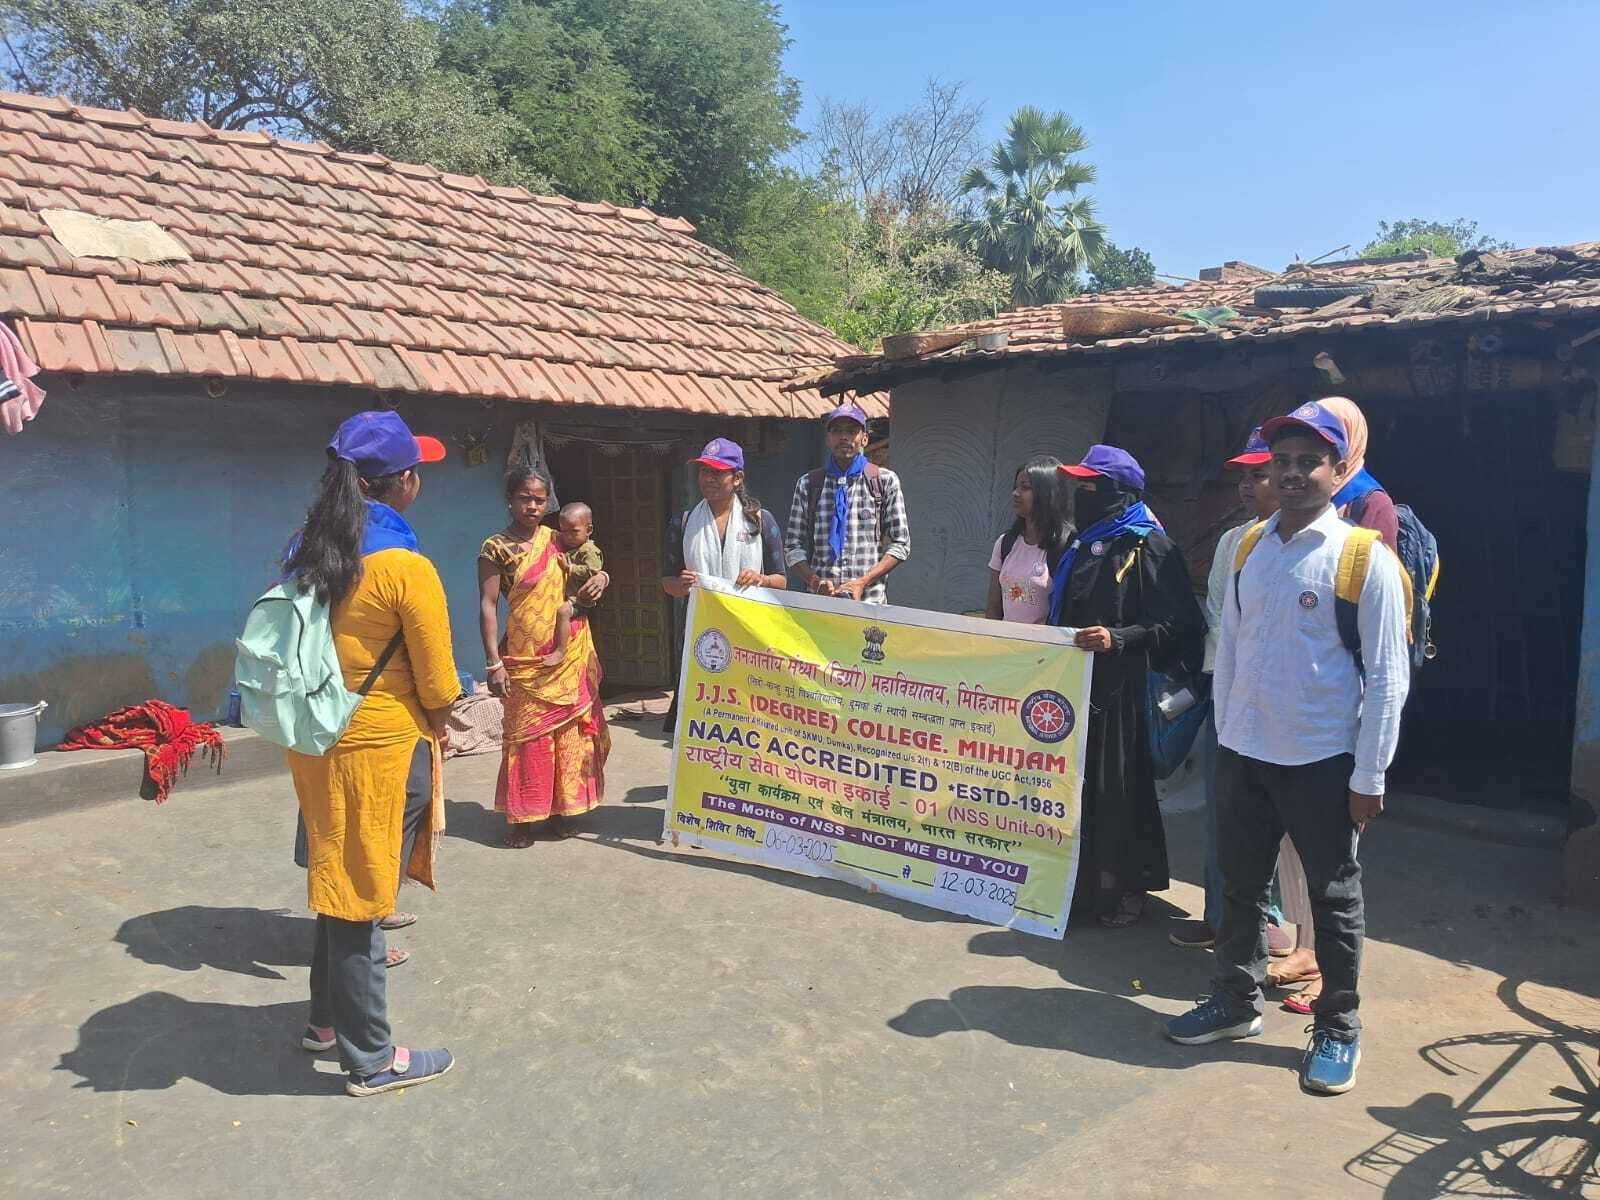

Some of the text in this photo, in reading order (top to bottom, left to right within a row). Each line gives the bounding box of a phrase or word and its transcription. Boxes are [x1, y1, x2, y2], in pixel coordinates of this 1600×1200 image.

[824, 660, 867, 692] (डिग्री)
[871, 672, 949, 709] महाविद्यालय,
[958, 682, 1021, 715] मिहिजाम
[688, 719, 761, 749] NAAC
[766, 737, 938, 793] ACCREDITED
[695, 682, 742, 705] J.J.S.
[750, 694, 838, 734] (DEGREE)
[958, 739, 1066, 775] MIHIJAM
[703, 709, 712, 719] (A
[713, 709, 751, 724] Permanent
[794, 729, 801, 739] of
[857, 744, 901, 761] Recognized
[903, 752, 916, 763] u/s
[933, 759, 939, 767] &
[942, 760, 963, 774] 12(B)
[965, 764, 974, 776] of
[975, 765, 989, 778] the
[991, 769, 1012, 782] UGC
[685, 746, 743, 770] राष्ट्रीय
[749, 752, 780, 778] सेवा
[784, 764, 837, 793] योजना
[843, 782, 891, 811] इकाई
[915, 798, 938, 818] 01
[947, 804, 990, 827] (NSS
[995, 815, 1064, 846] Unit-01)
[758, 783, 800, 805] कार्यक्रम
[808, 795, 824, 811] एवं
[831, 801, 853, 819] खेल
[861, 810, 911, 834] मंत्रालय,
[921, 823, 956, 841] भारत
[676, 811, 702, 828] विशेष
[705, 818, 732, 834] शिविर
[735, 825, 756, 840] तिथि
[902, 864, 912, 880] से
[707, 796, 737, 811] The
[741, 801, 785, 822] Motto
[789, 815, 807, 827] of
[810, 819, 845, 837] NSS
[861, 831, 899, 848] NOT
[904, 841, 930, 856] ME
[936, 849, 972, 866] BUT
[980, 858, 1020, 878] YOU
